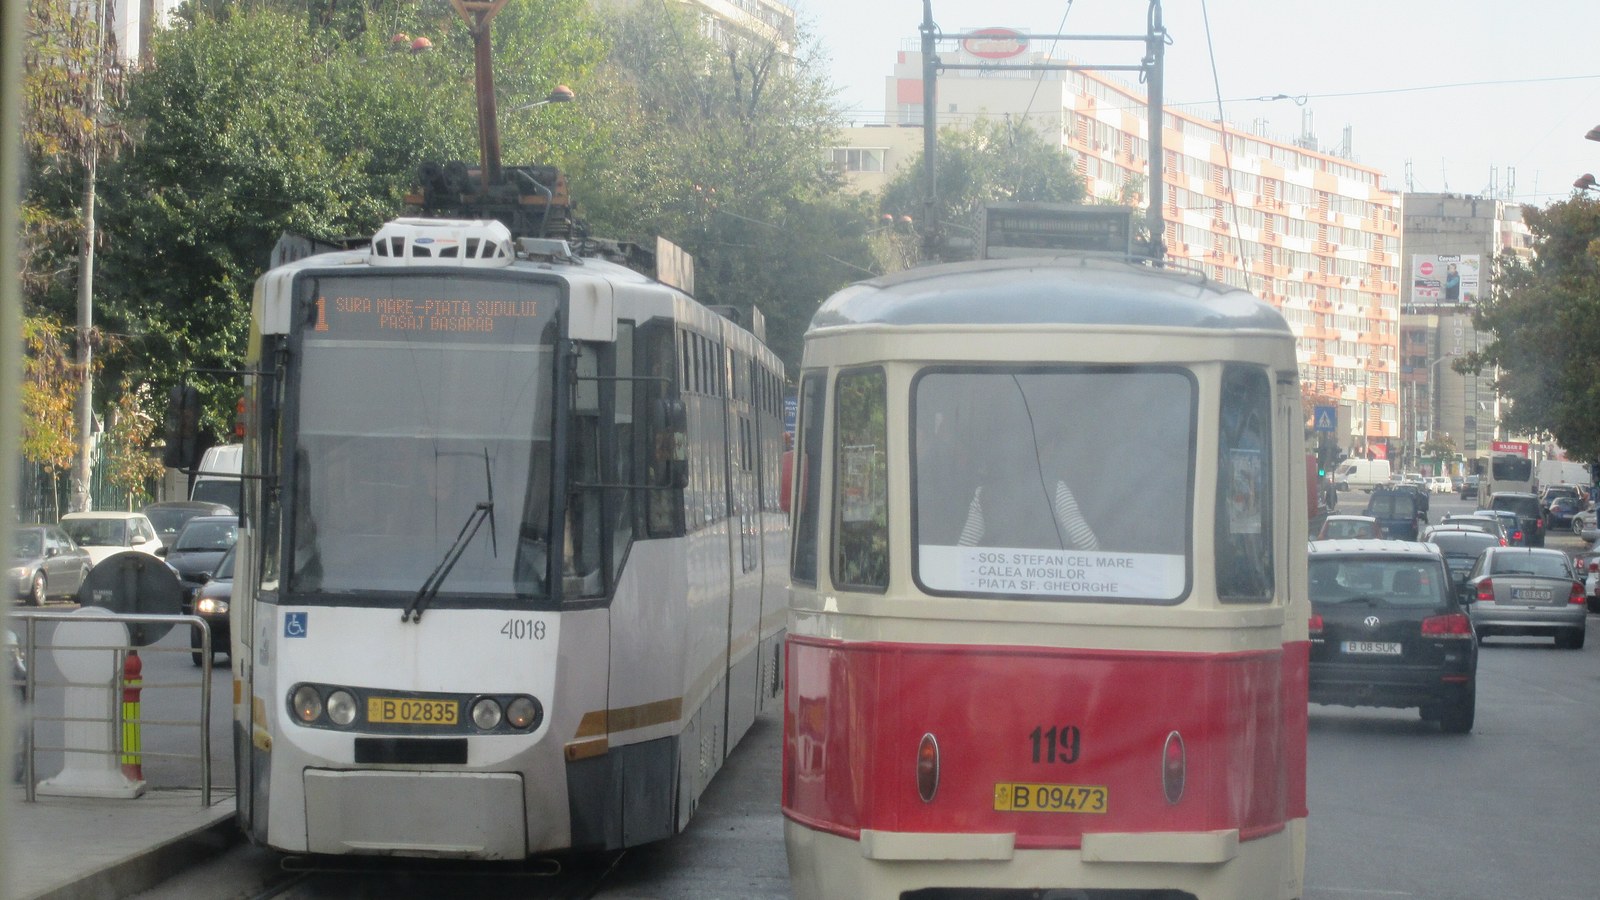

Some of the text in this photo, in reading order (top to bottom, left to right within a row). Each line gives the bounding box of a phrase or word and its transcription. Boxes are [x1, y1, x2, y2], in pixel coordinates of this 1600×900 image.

[315, 297, 329, 331] 1
[336, 297, 371, 312] SURA
[476, 300, 537, 316] SUDULUI
[380, 315, 493, 332] PASAJ BASARAB
[978, 552, 1134, 569] SOS. STEFAN CEL MARE
[978, 565, 1086, 579] CALEA MOSILOR
[978, 578, 1016, 589] PIATA
[1043, 581, 1119, 593] GHEORGHE
[500, 618, 546, 640] 4018
[1349, 641, 1398, 653] B 08 SUK
[383, 701, 456, 722] B 02835
[1028, 725, 1081, 764] 119
[1013, 786, 1105, 810] B 09473
